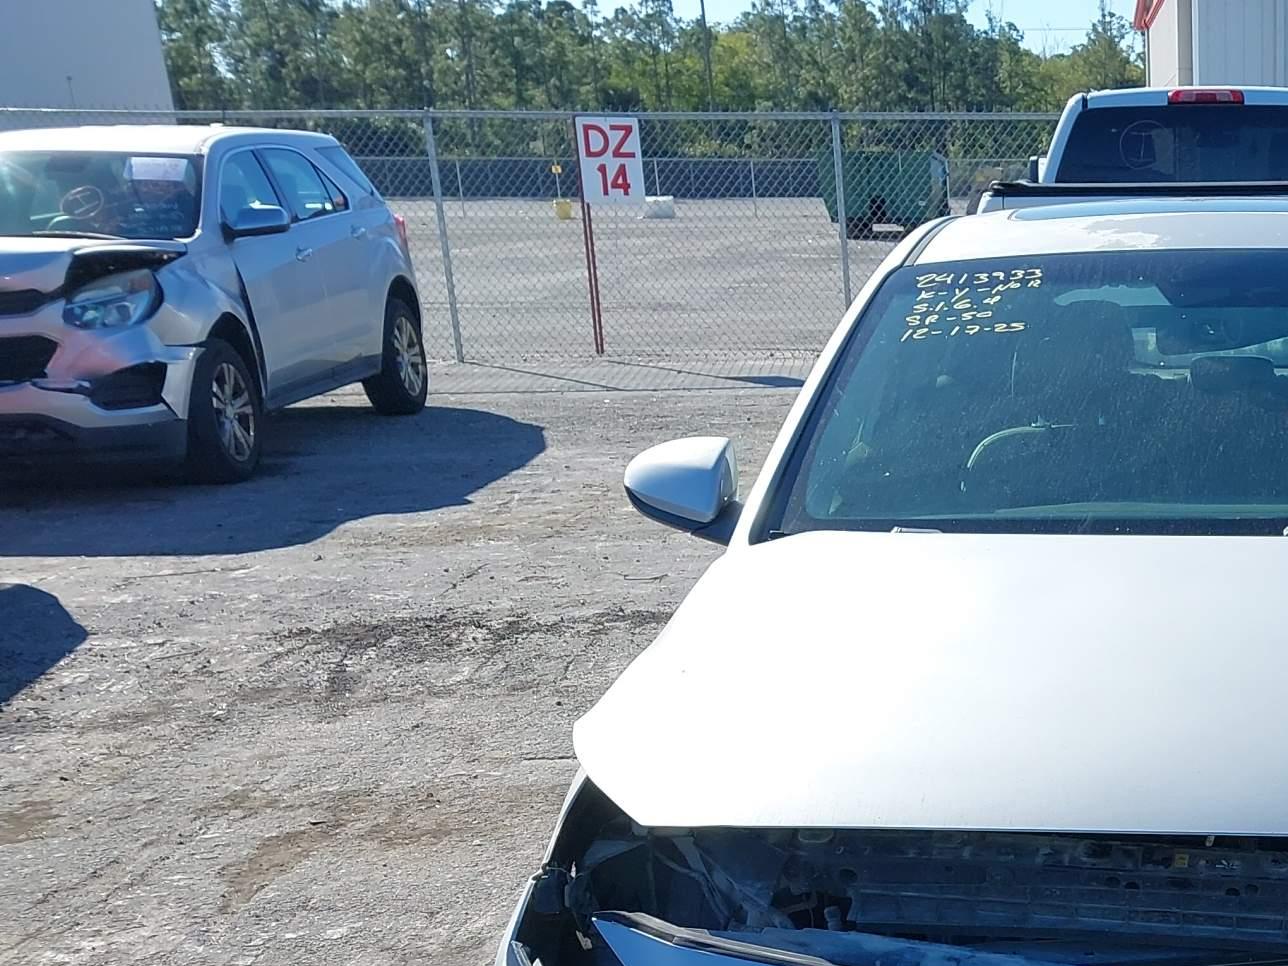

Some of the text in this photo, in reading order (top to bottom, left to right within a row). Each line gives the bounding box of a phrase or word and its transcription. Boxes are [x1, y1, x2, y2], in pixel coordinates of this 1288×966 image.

[582, 123, 636, 158] DZ
[596, 163, 631, 196] 14
[900, 322, 1025, 342] 12-17-25
